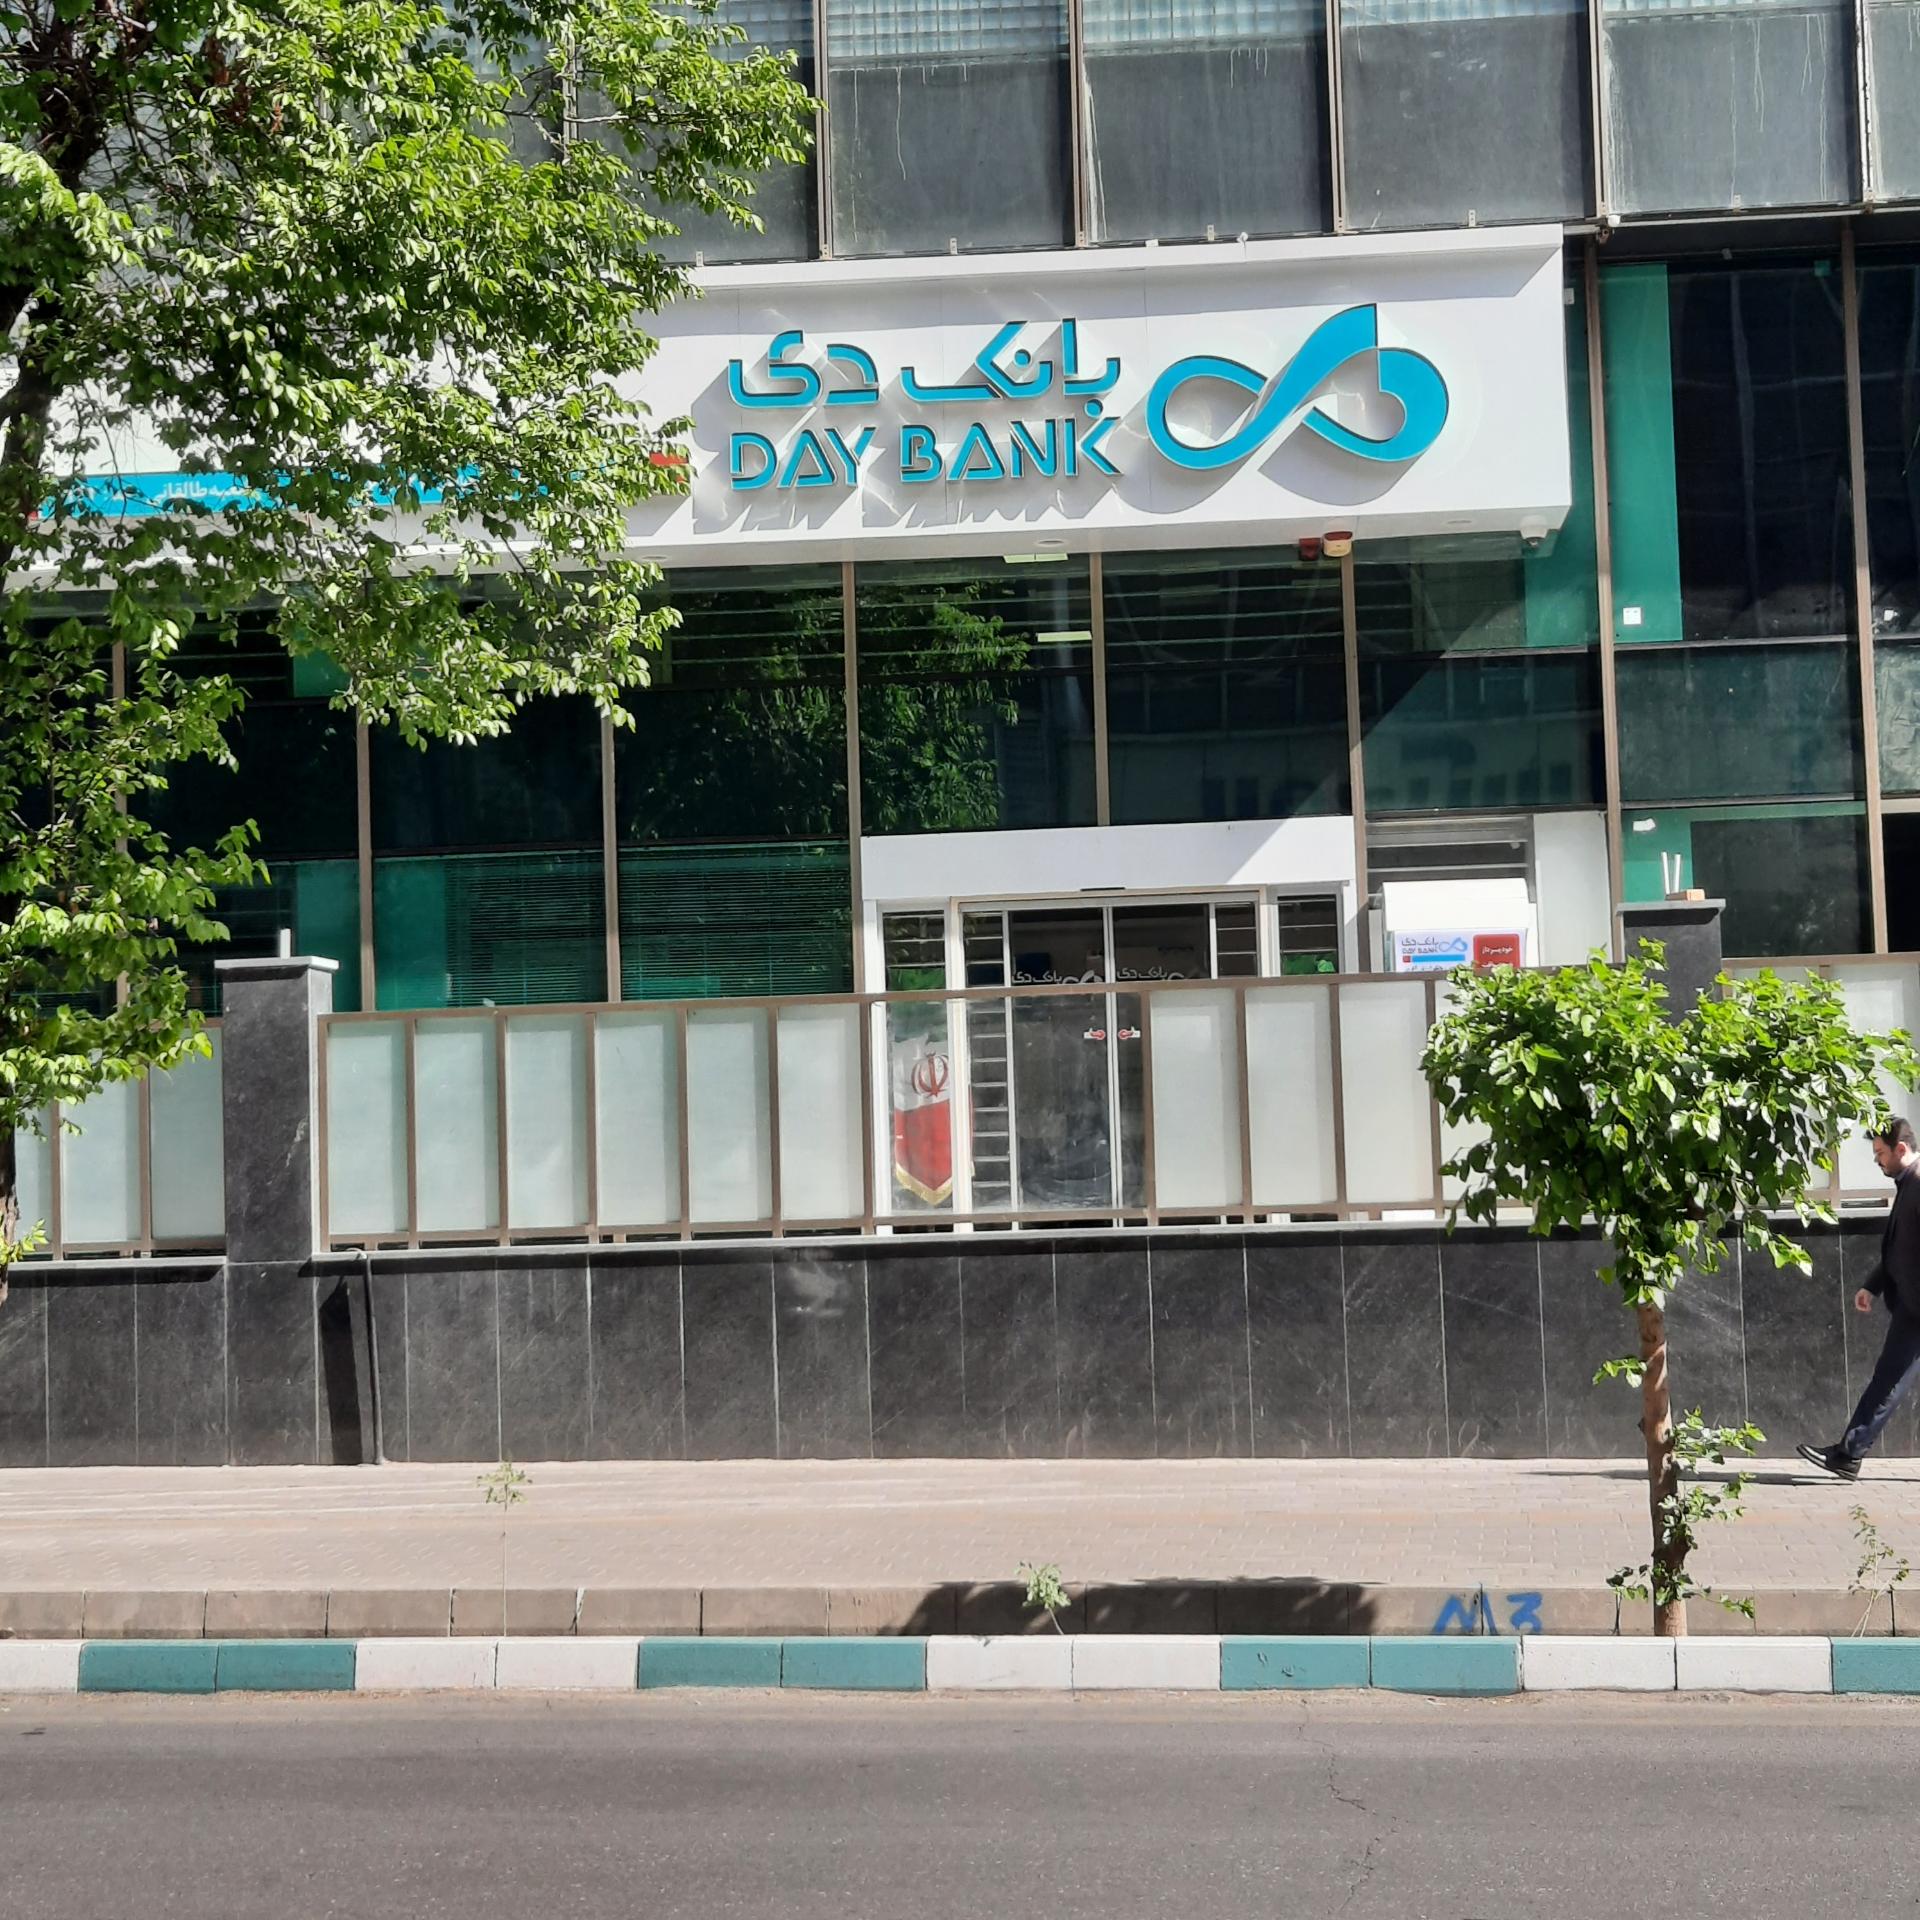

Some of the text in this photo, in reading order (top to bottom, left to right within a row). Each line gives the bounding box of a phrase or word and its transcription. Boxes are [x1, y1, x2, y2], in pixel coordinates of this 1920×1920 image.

[728, 317, 1121, 418] بانک دی
[730, 417, 1125, 490] DAY BANK
